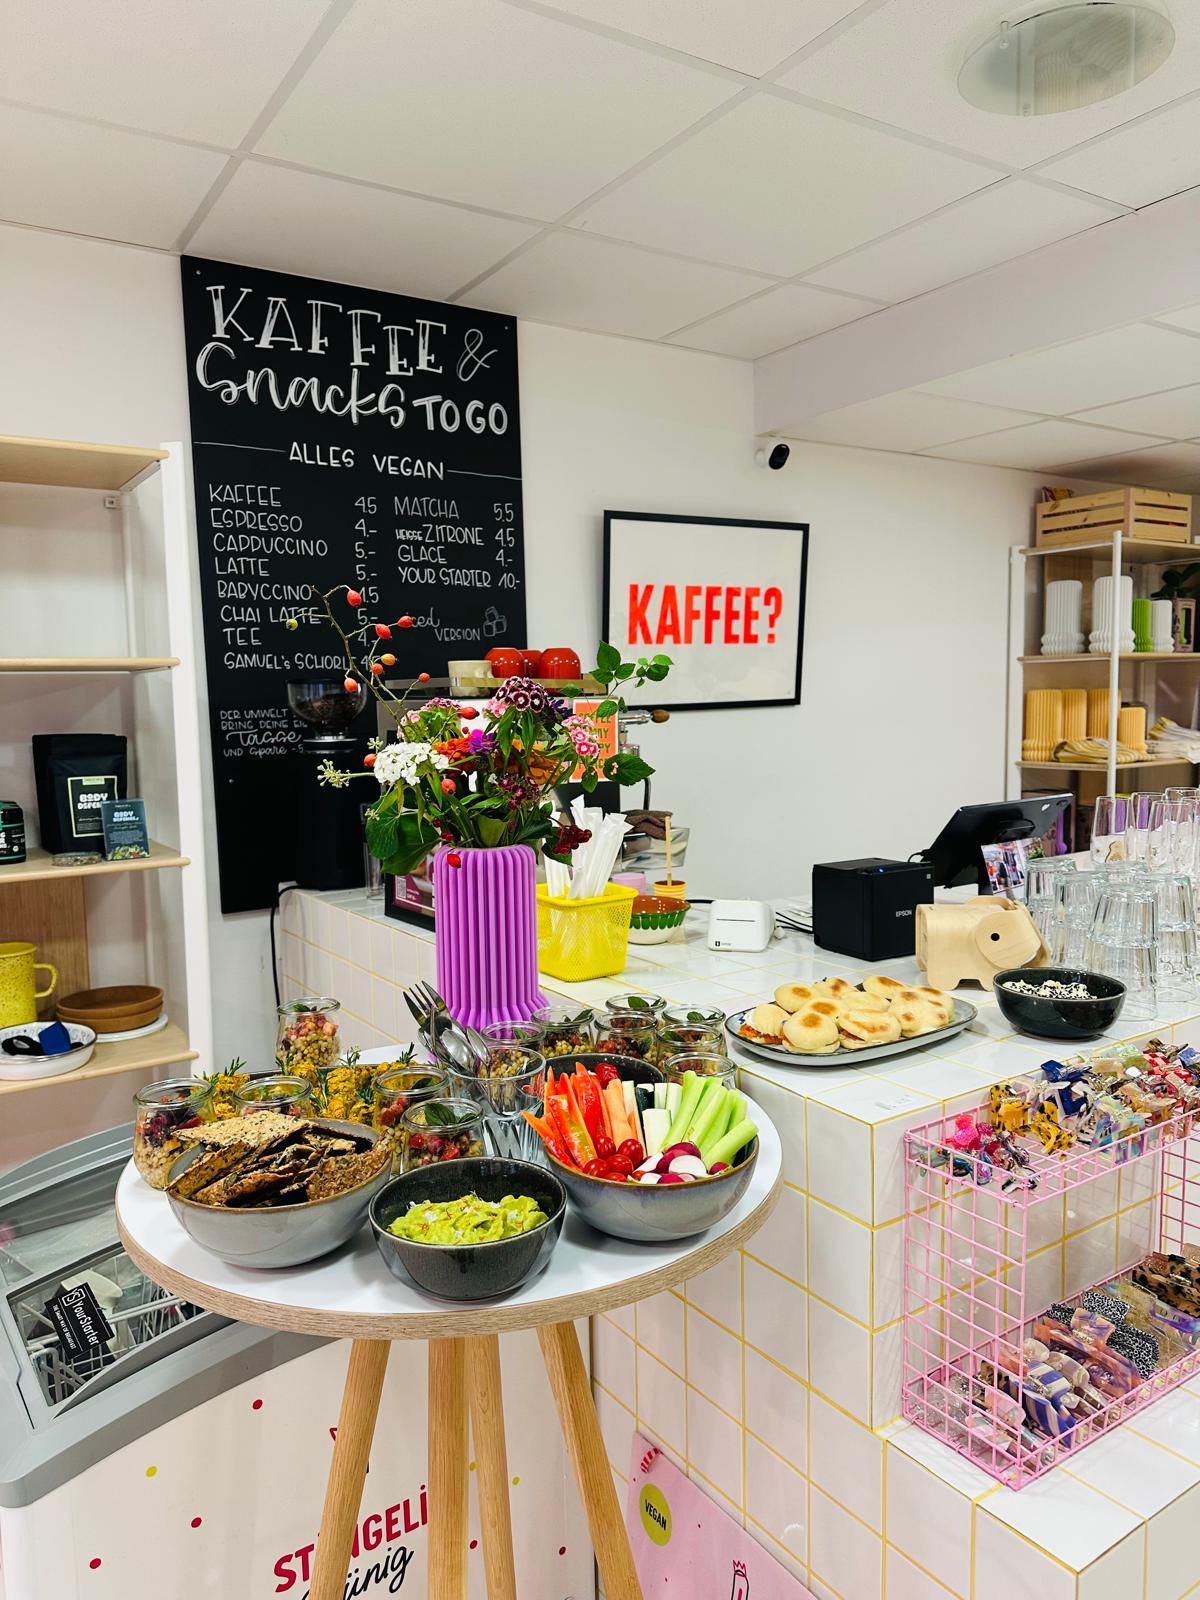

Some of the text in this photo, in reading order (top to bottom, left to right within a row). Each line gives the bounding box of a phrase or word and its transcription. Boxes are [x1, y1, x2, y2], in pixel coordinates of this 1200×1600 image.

[205, 285, 499, 383] KAFFEE &
[195, 341, 407, 430] Snacks
[288, 441, 444, 481] ALLES VEGAN
[208, 483, 282, 507] KAFFEE
[210, 507, 303, 533] ESPRESSO
[393, 495, 515, 523] MATCHA 5.5
[212, 532, 329, 557] CAPPUCCINO
[422, 523, 485, 546] ZITRONE
[397, 544, 448, 564] GLACE
[214, 556, 270, 577] LATTE
[397, 565, 437, 584] YOUR
[438, 566, 493, 588] STARTER
[216, 579, 313, 602] BABYCCINO
[219, 604, 261, 624] CHAI
[268, 606, 322, 625] LATTE
[628, 583, 783, 645] KAFFEE?
[222, 626, 263, 646] TEE
[433, 627, 481, 642] VERSION
[219, 708, 289, 720] DER UMWELT
[220, 720, 254, 731] BRING
[259, 719, 289, 729] DEINE
[223, 747, 244, 757] UND
[895, 909, 913, 918] EPSON
[72, 1300, 100, 1346] YourStarter
[643, 1498, 667, 1532] VEGAN
